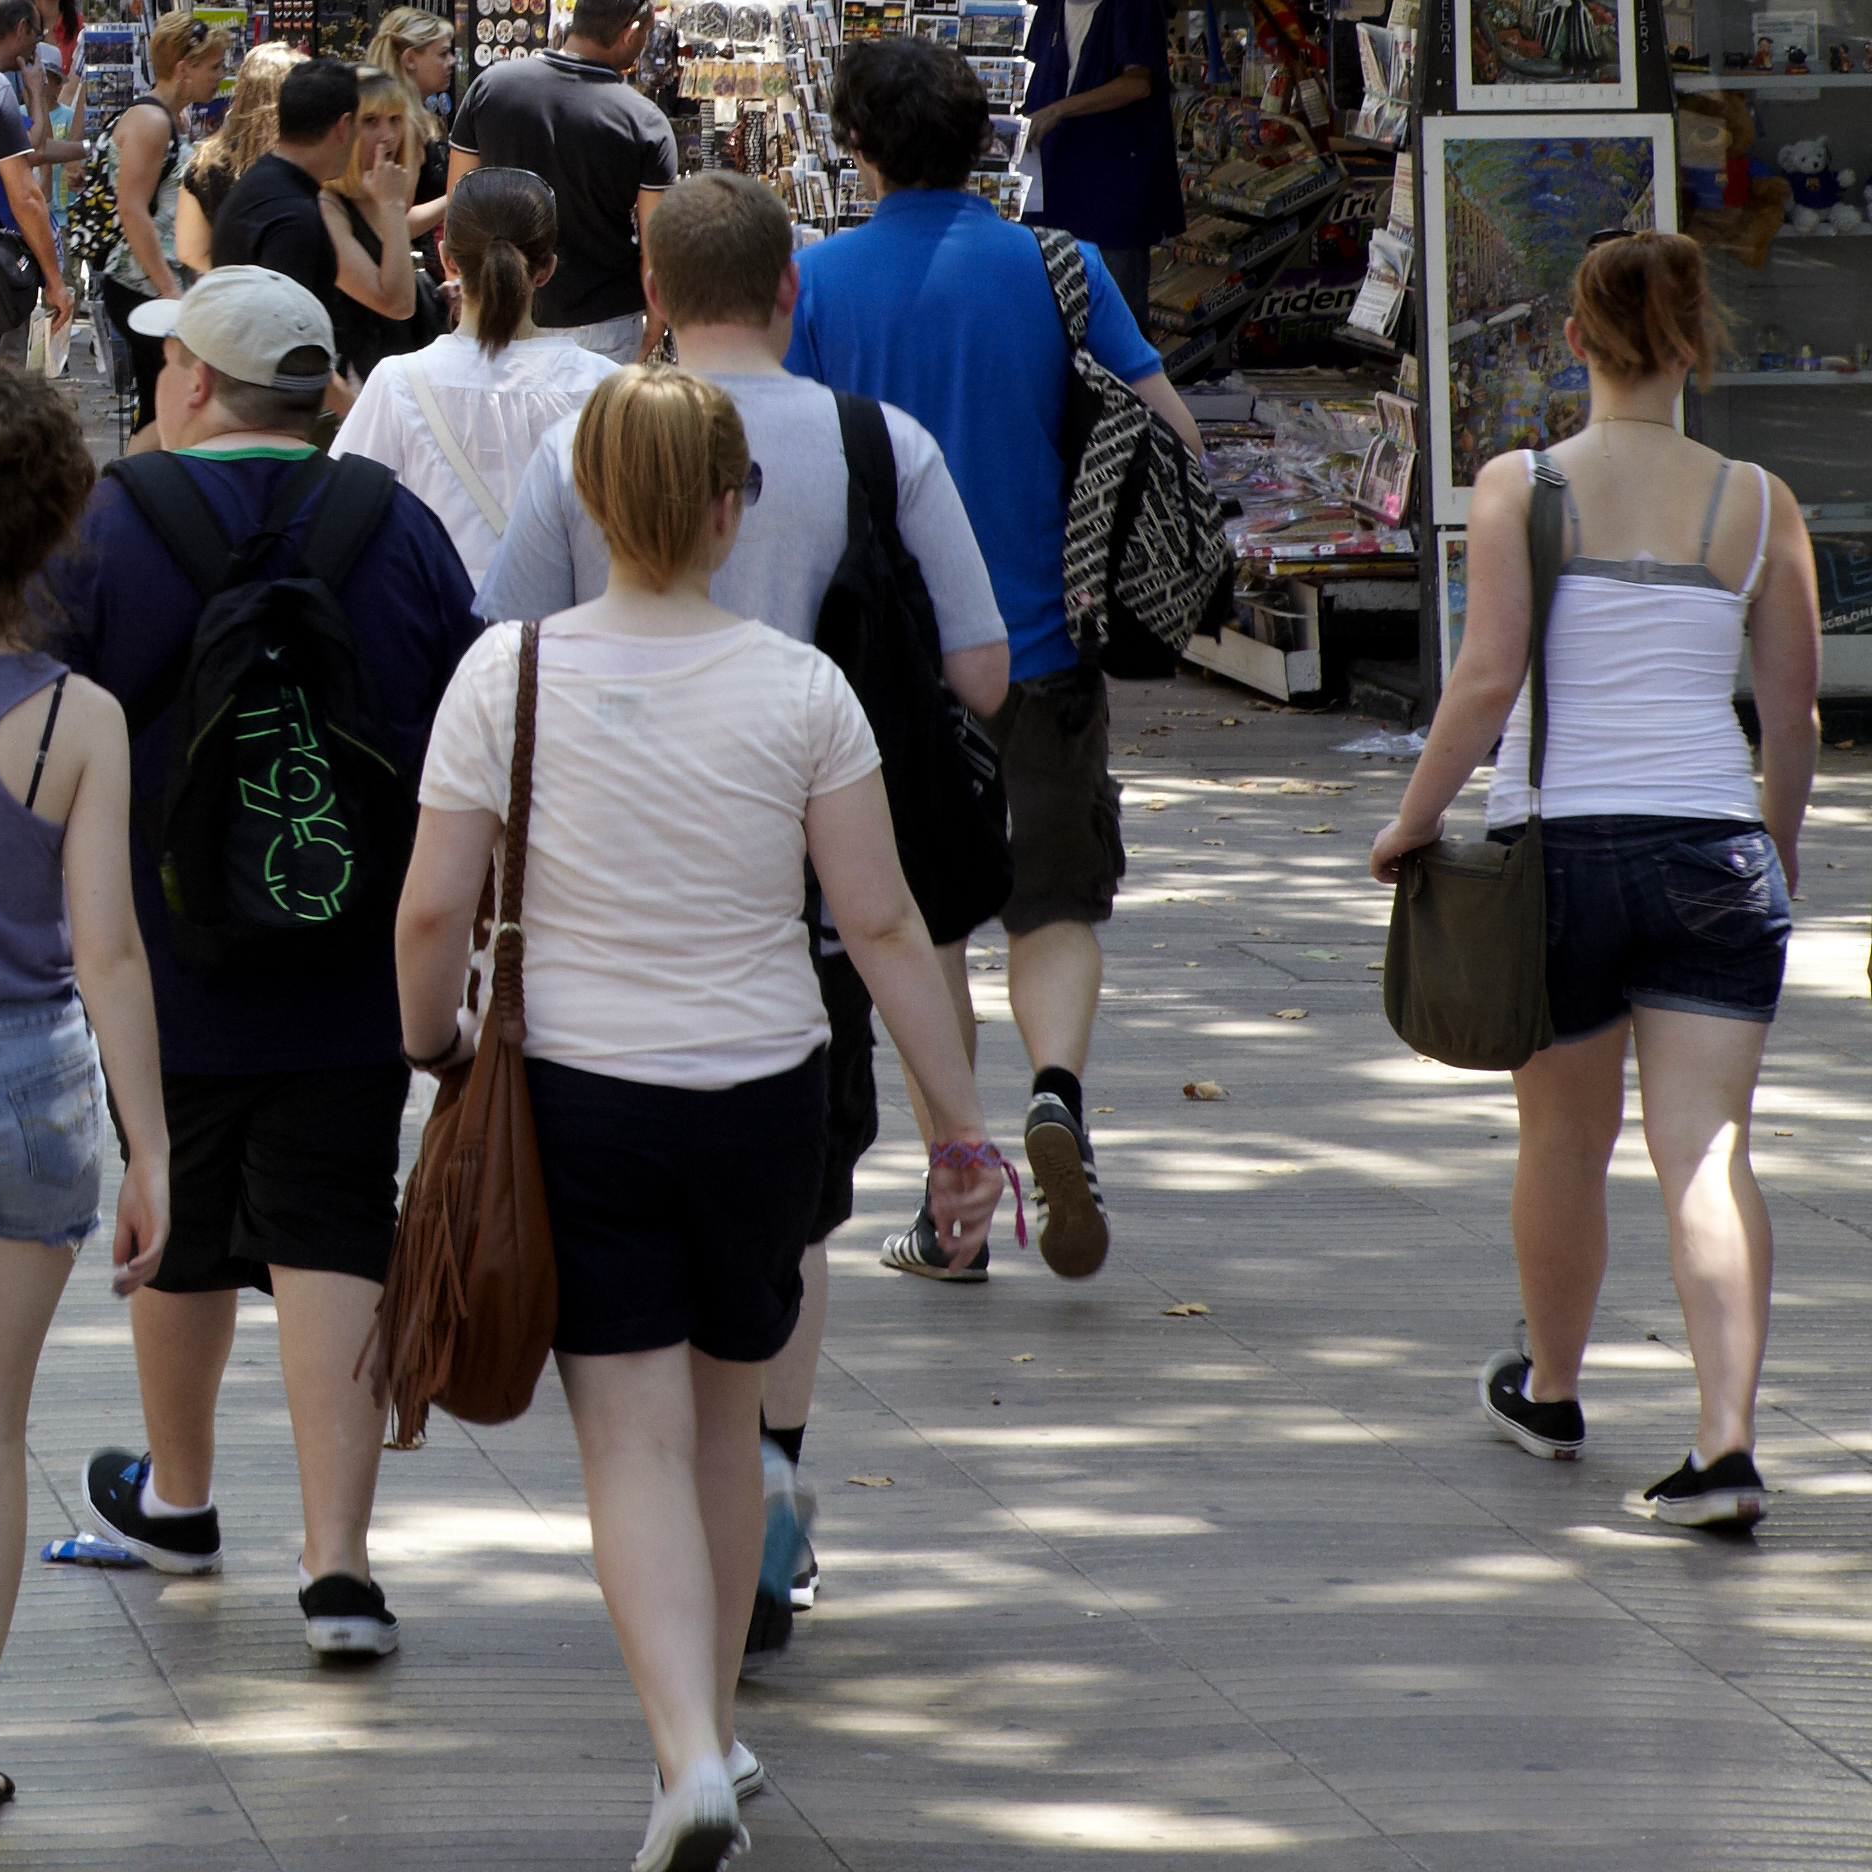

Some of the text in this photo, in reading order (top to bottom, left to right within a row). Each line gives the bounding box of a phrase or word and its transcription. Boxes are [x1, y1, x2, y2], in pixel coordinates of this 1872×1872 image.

[1280, 172, 1330, 209] Trident
[1331, 190, 1376, 223] Tri
[1241, 225, 1290, 262] Trident
[1207, 285, 1244, 310] Trident
[1252, 286, 1354, 319] Triden
